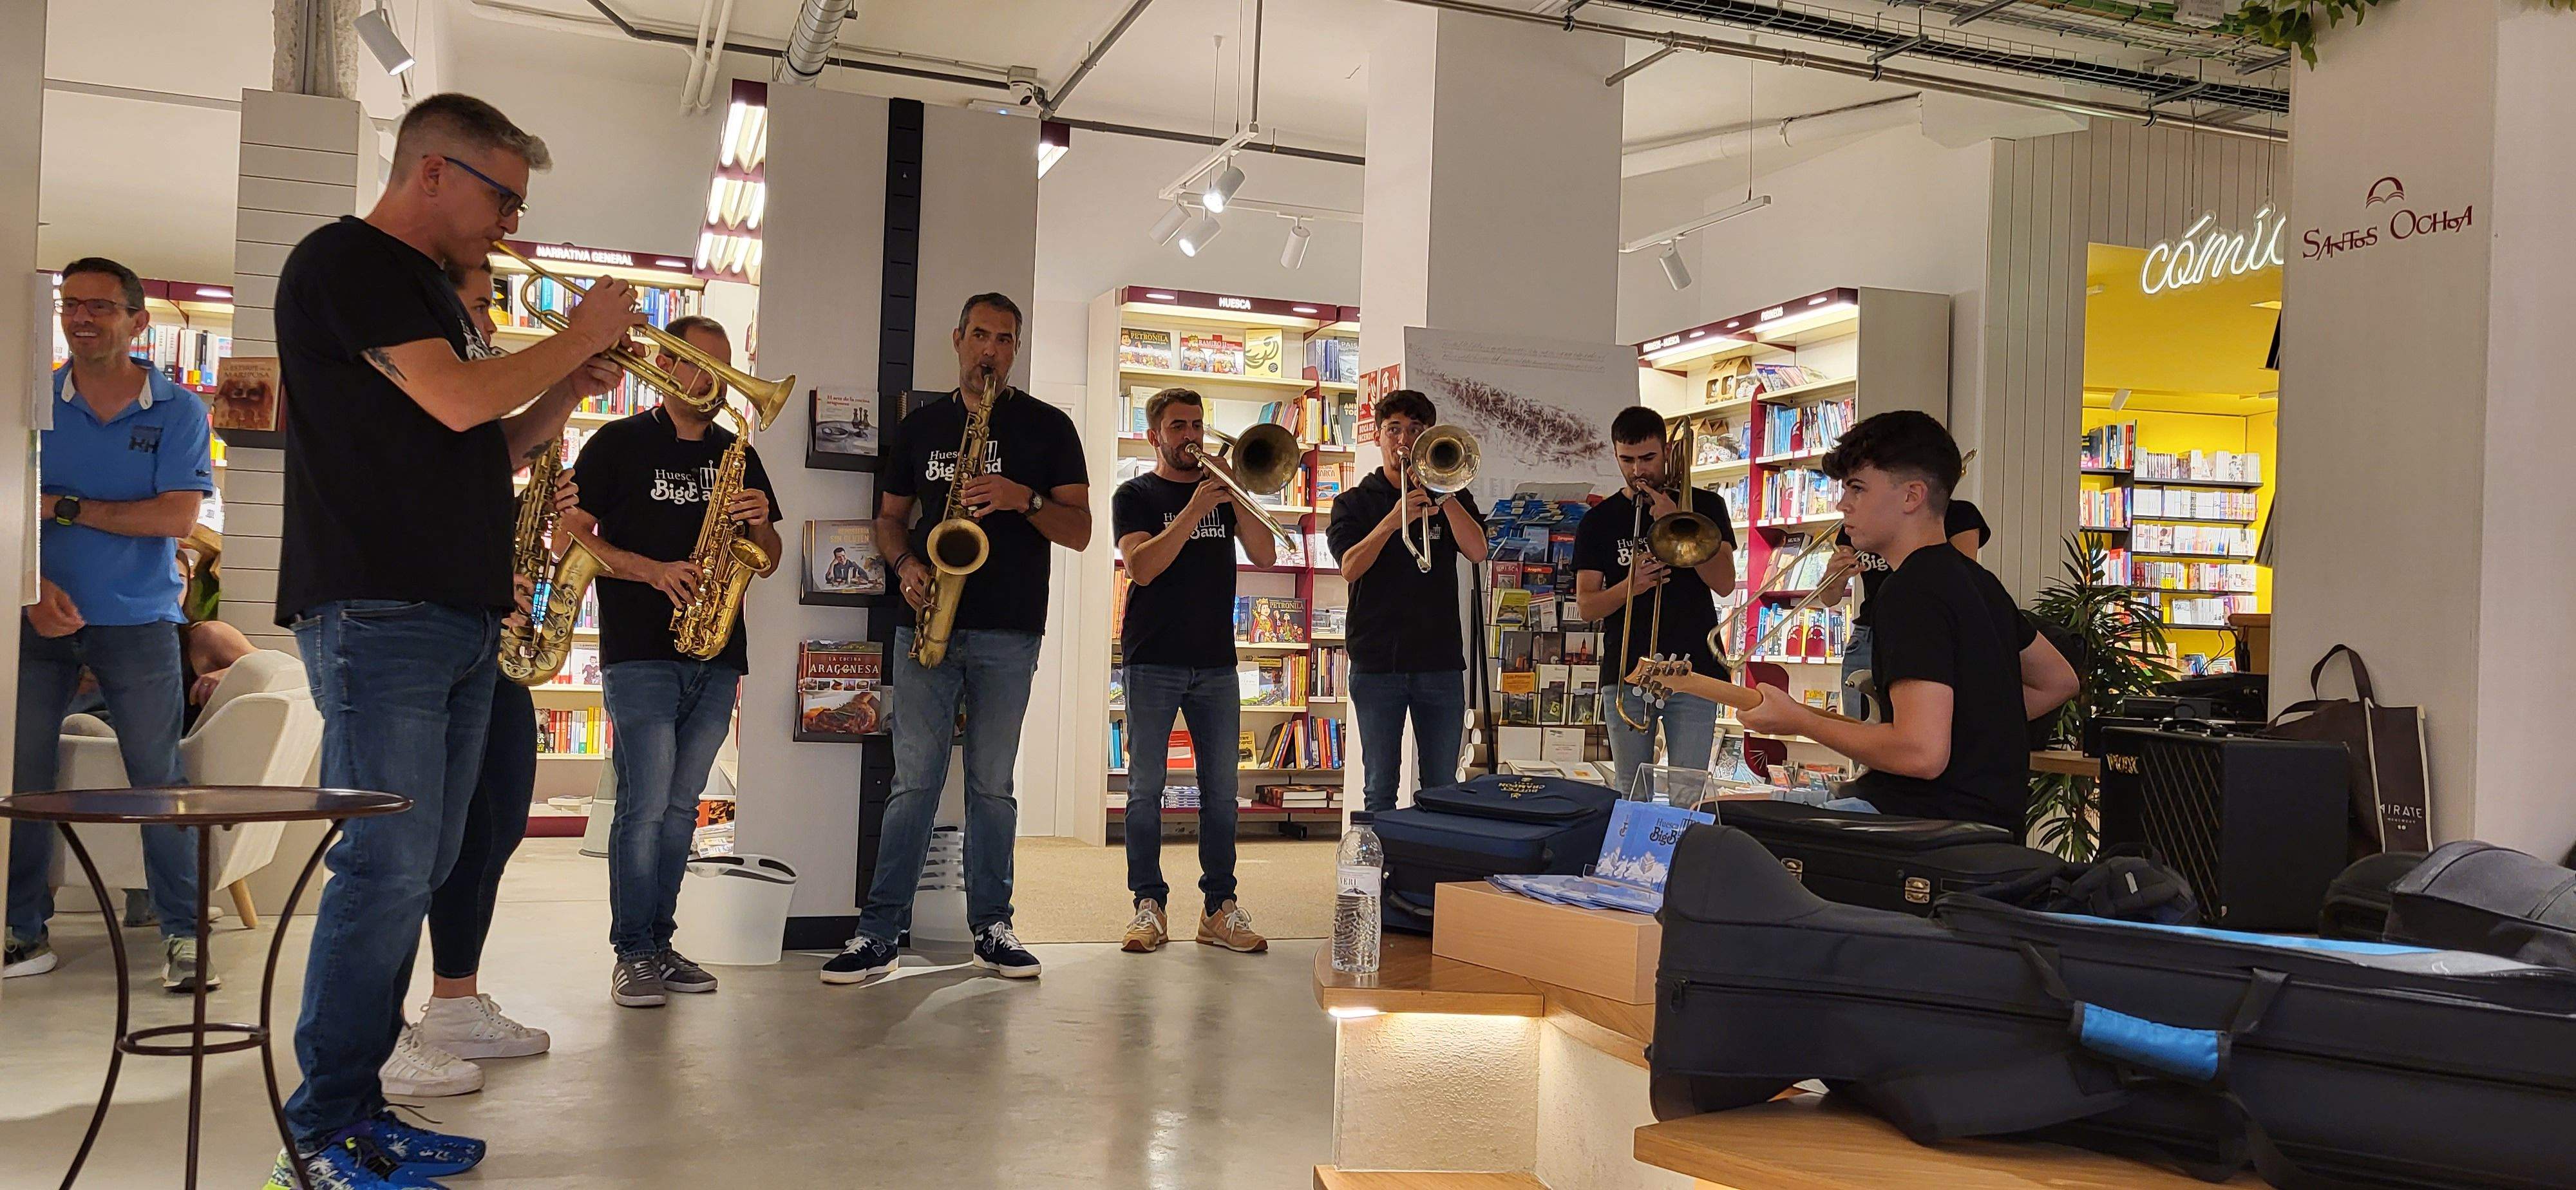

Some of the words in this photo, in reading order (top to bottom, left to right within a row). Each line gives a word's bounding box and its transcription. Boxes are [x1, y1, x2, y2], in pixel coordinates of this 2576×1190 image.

[536, 245, 591, 261] NARRATIVA
[591, 252, 634, 266] GENERAL
[1218, 297, 1251, 310] HUESCA
[1130, 332, 1169, 343] PETRONILA
[1198, 339, 1222, 348] RAMIRO
[1269, 601, 1303, 610] PETRONILA
[810, 664, 880, 675] ARAGONESA
[1656, 818, 1679, 829] Huesca
[1340, 876, 1356, 886] VERI
